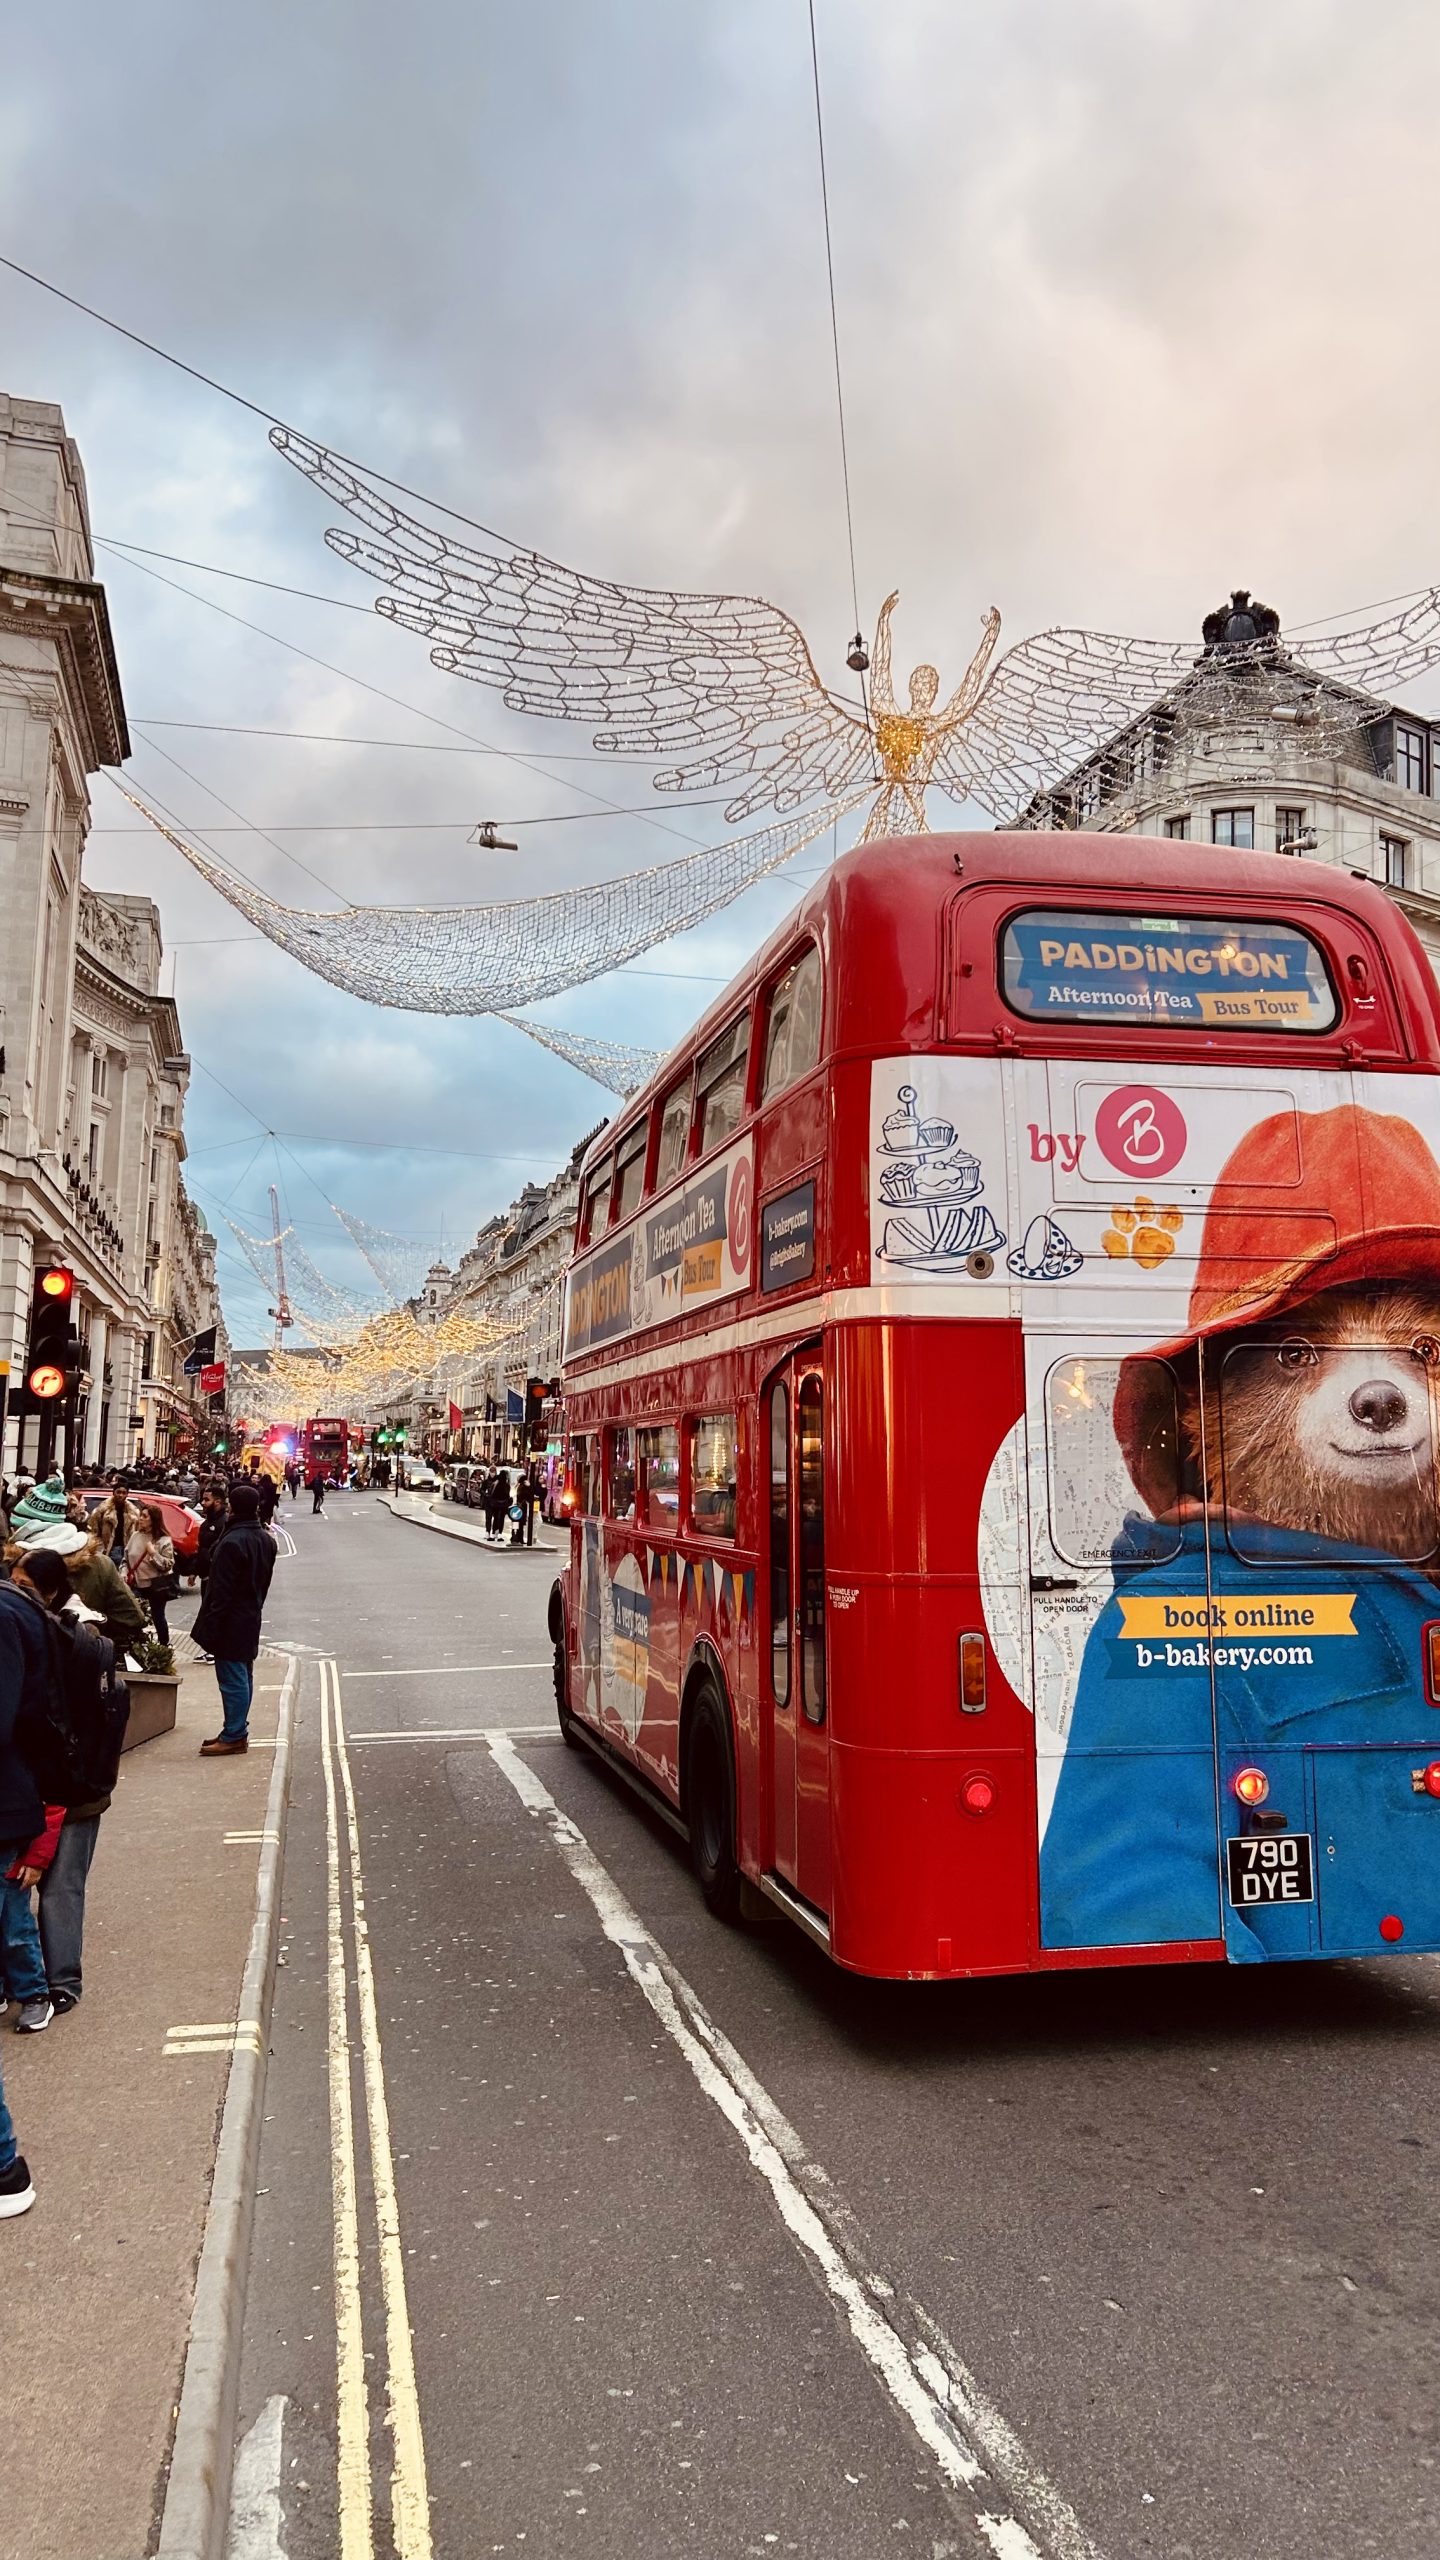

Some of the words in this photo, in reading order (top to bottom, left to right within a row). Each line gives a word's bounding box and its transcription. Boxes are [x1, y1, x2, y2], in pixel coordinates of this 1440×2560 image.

[1048, 985, 1151, 1007] Afternoon
[1156, 990, 1193, 1009] Tea
[1214, 999, 1250, 1015] Bus
[1257, 999, 1299, 1015] Tour
[1027, 1124, 1086, 1172] by
[652, 1211, 696, 1261] Afternoon
[697, 1194, 716, 1233] Tea
[683, 1259, 697, 1285] Bus
[698, 1255, 716, 1281] Tour
[1082, 1549, 1136, 1559] EMERGENCY
[1043, 1605, 1065, 1613] OPEN
[1066, 1605, 1089, 1613] DOOR
[1054, 1596, 1085, 1604] HANDLE
[1164, 1603, 1227, 1627] book
[1233, 1602, 1315, 1627] online
[1136, 1643, 1314, 1671] b-bakery.com
[1240, 1840, 1298, 1868] 790
[1242, 1871, 1300, 1901] DYE
